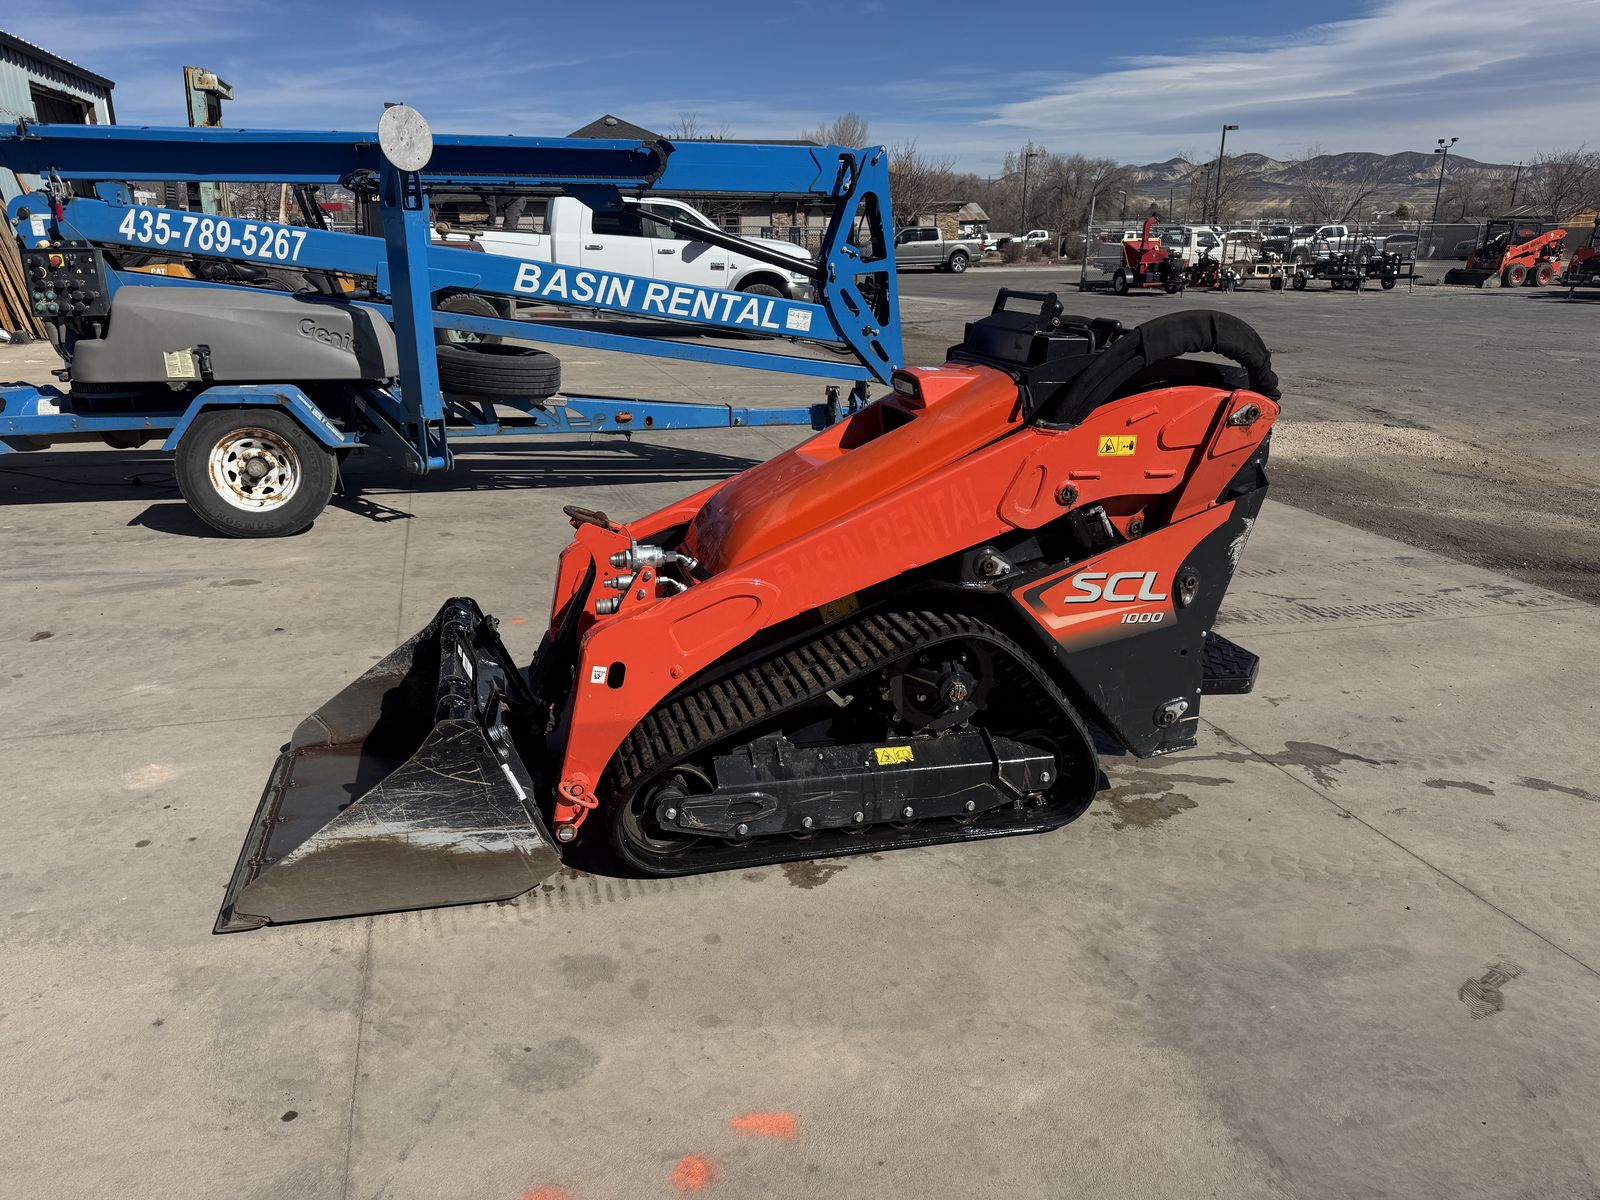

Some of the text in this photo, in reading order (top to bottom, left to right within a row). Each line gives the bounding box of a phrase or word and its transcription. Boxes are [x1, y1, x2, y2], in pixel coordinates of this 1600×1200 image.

[119, 207, 308, 262] 435-789-5267
[150, 267, 166, 275] CAT
[513, 262, 635, 308] BASIN
[642, 282, 781, 330] RENTAL
[216, 512, 274, 530] SAMSON
[870, 477, 993, 555] RENTAL
[1063, 571, 1168, 604] SCL
[1120, 612, 1165, 625] 1000
